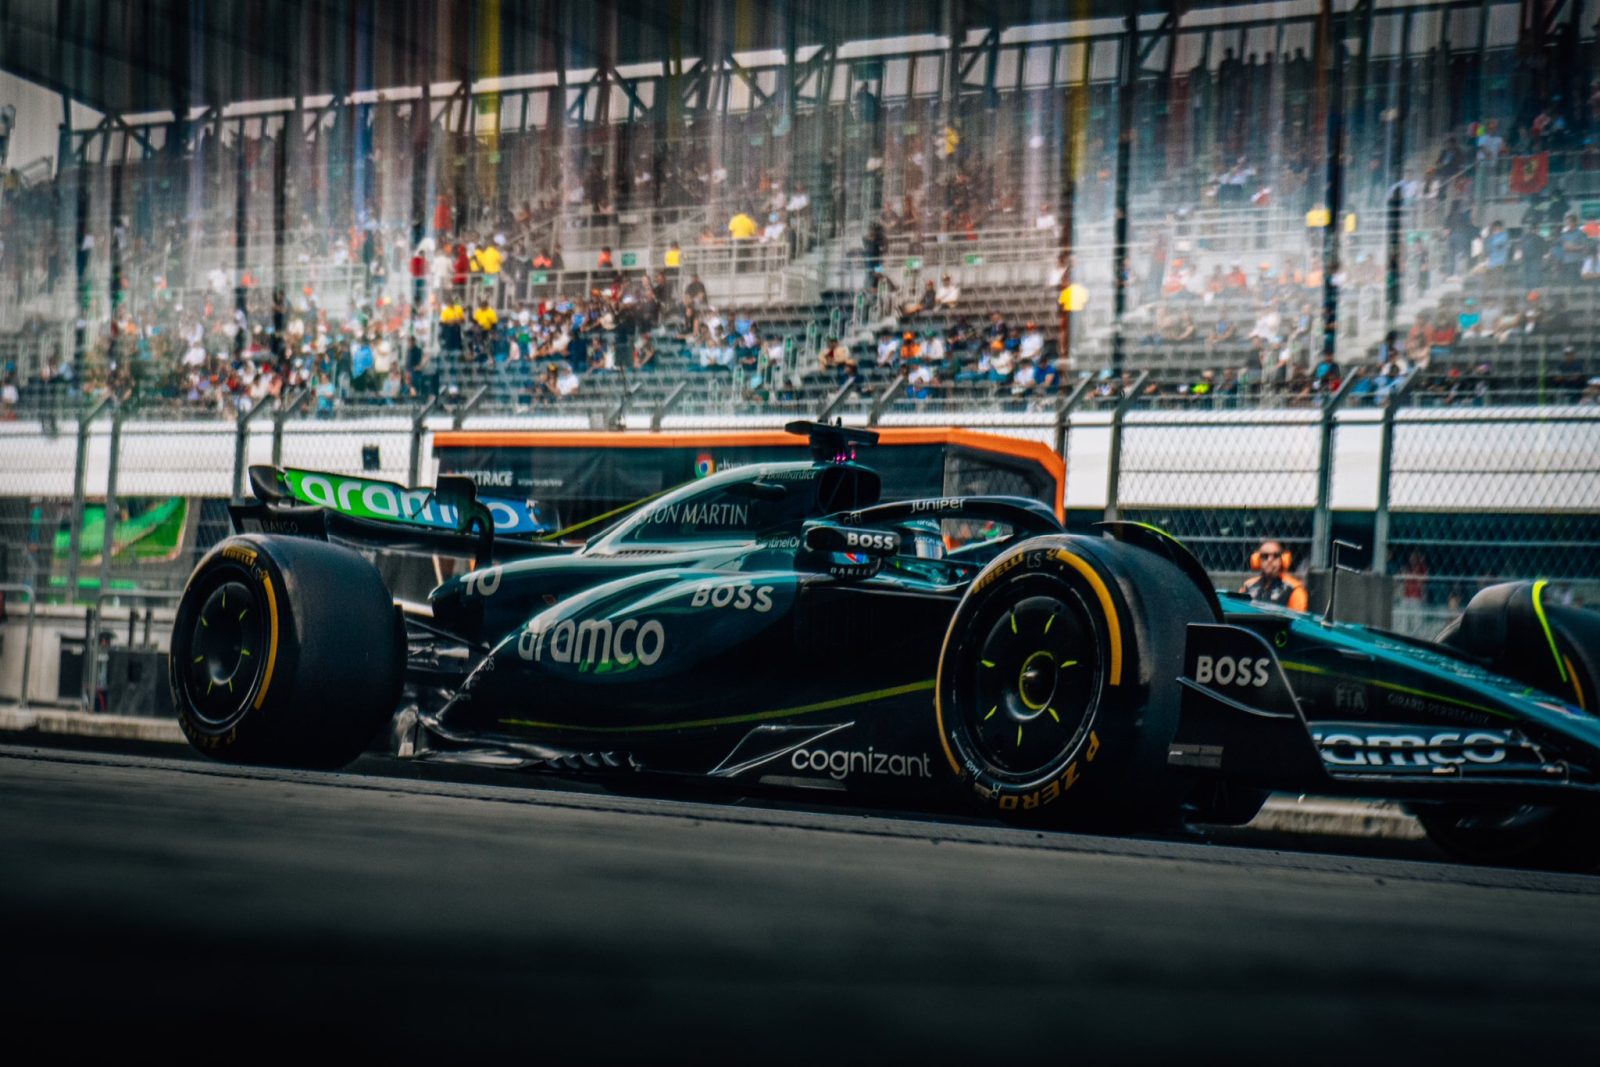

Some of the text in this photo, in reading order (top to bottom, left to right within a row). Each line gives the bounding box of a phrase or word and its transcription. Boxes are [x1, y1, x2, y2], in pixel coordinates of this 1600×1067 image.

[301, 476, 519, 530] aramo
[681, 503, 748, 525] MARTIN
[847, 532, 894, 550] BOSS
[464, 566, 503, 597] 10
[690, 583, 774, 613] BOSS
[517, 618, 665, 666] aramco
[1196, 655, 1270, 687] BOSS
[791, 746, 932, 780] cognizant
[1313, 732, 1507, 766] amco
